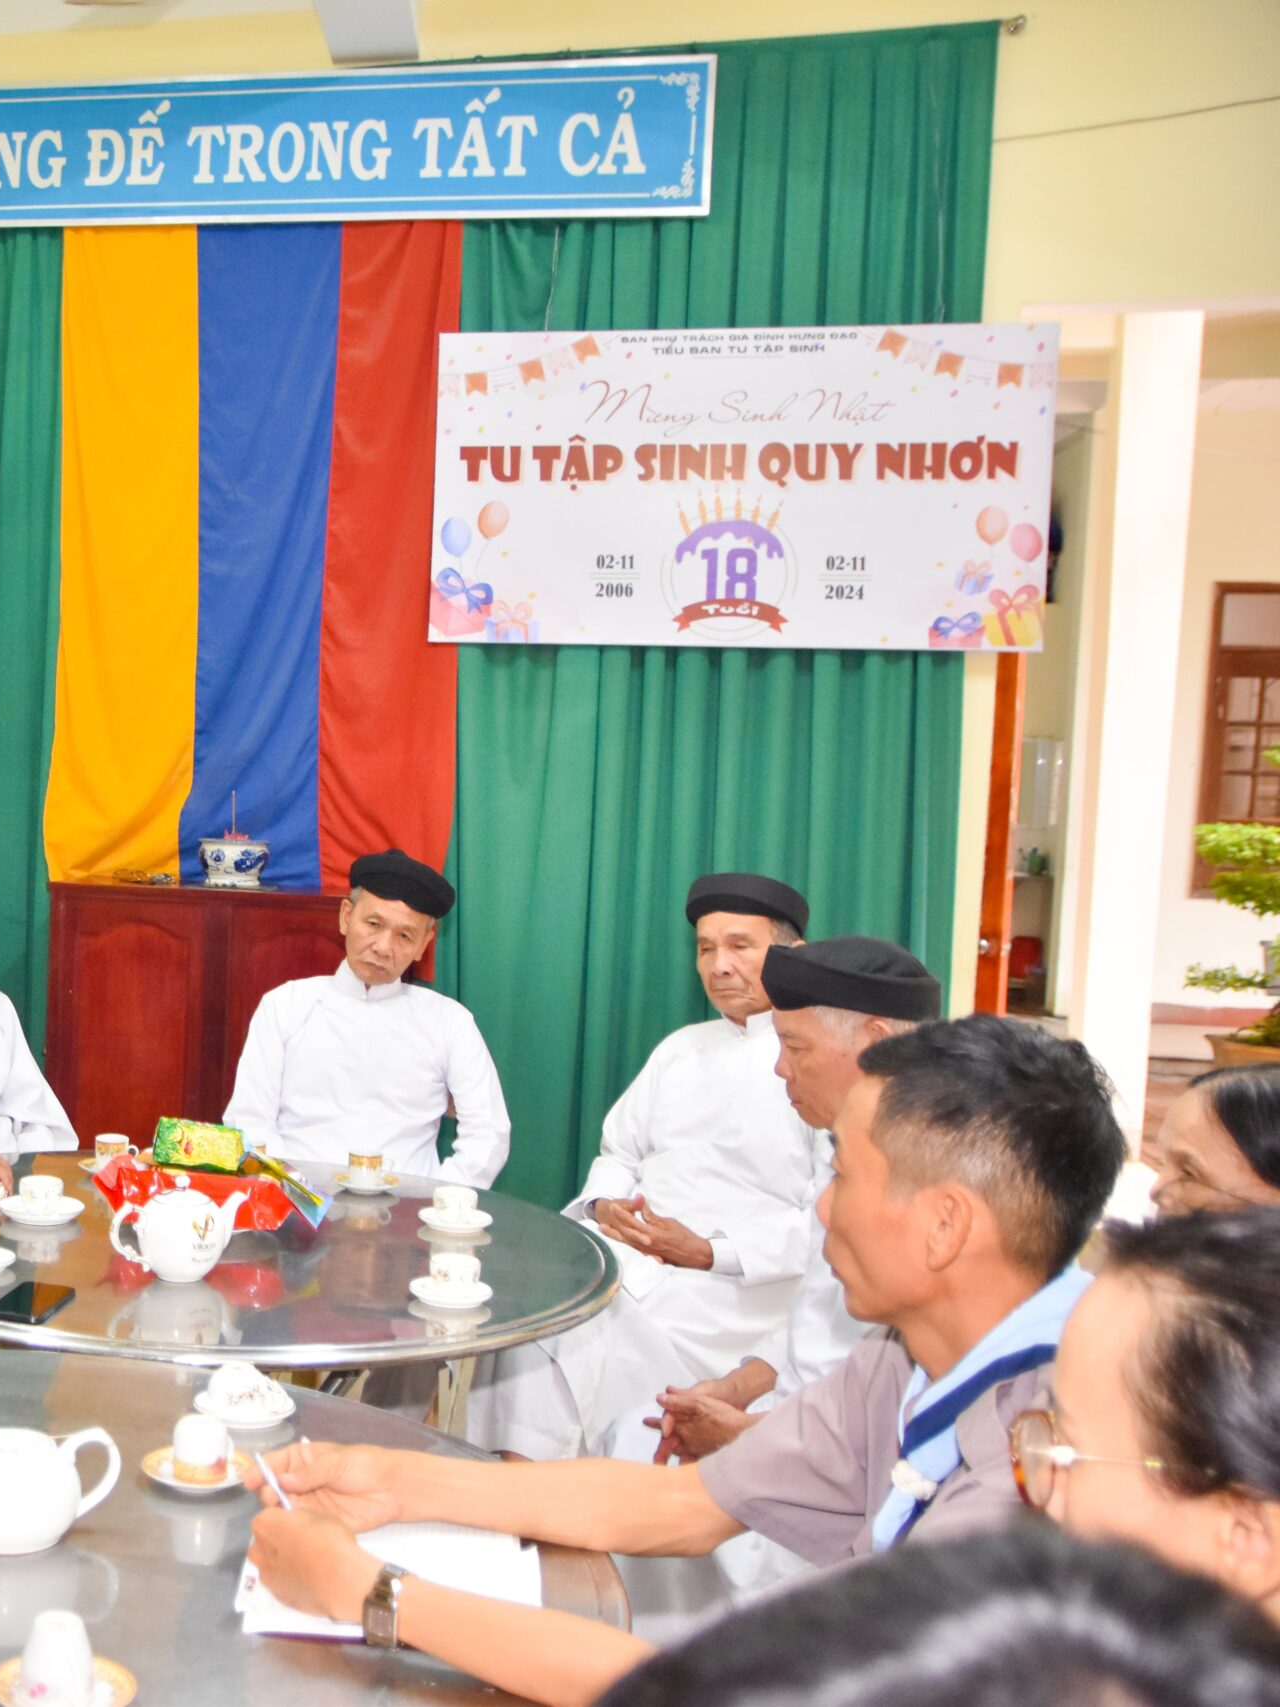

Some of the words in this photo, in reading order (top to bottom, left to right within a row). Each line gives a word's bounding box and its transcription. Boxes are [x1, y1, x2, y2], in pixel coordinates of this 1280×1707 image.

[83, 99, 172, 187] ĐẾ
[186, 118, 393, 185] TRONG
[412, 86, 538, 179] TẤT
[558, 86, 647, 177] CẢ
[620, 334, 648, 344] BAN
[728, 333, 750, 342] GIA
[688, 345, 722, 355] BAN
[728, 344, 748, 354] TU
[789, 343, 827, 354] SINH
[708, 390, 799, 424] Sinh
[799, 388, 897, 427] Nhật
[460, 446, 522, 483] TU
[532, 434, 623, 491] TẬP
[634, 444, 748, 483] SINH
[759, 443, 863, 487] QUY
[876, 434, 1020, 482] NHƠN
[595, 553, 636, 570] 02-11
[825, 555, 867, 572] 02-11
[700, 547, 758, 601] 18
[594, 582, 634, 598] 2006
[824, 584, 865, 600] 2024
